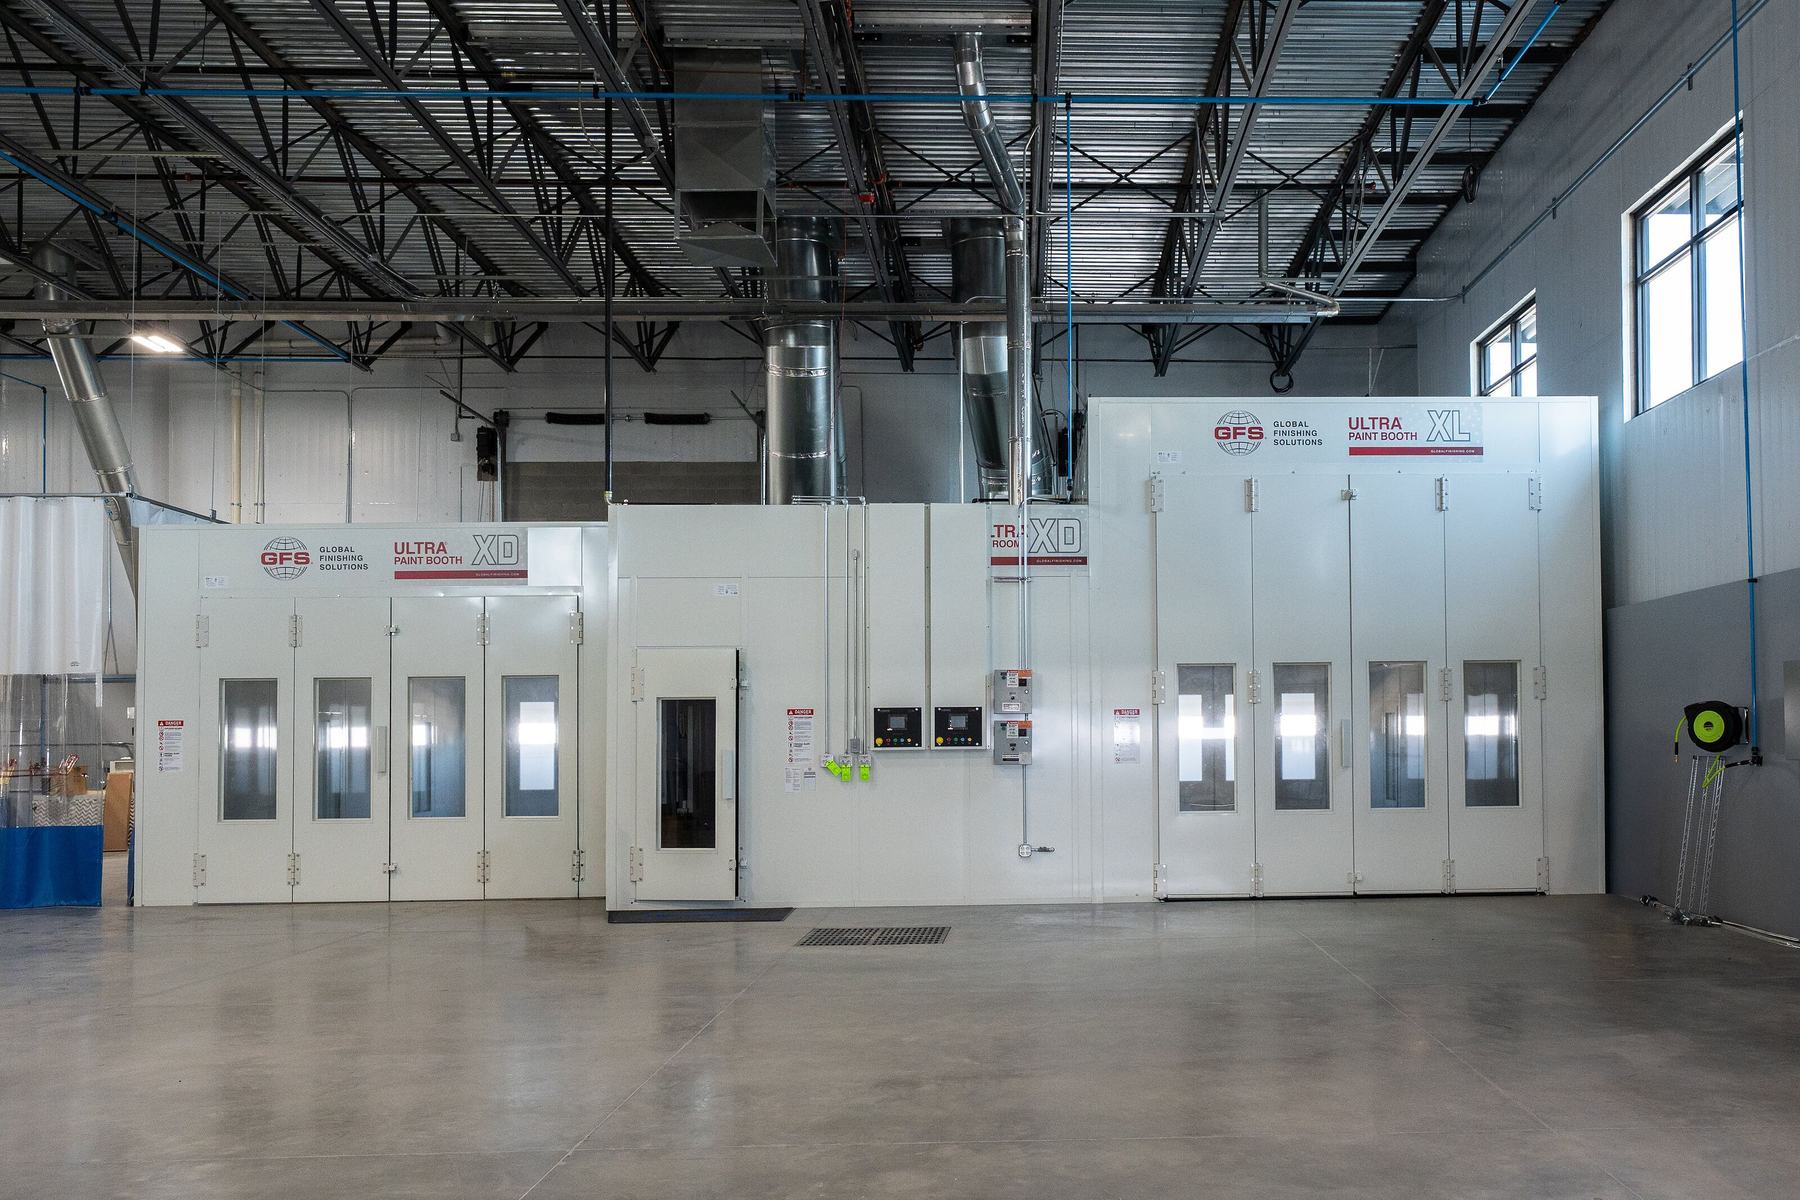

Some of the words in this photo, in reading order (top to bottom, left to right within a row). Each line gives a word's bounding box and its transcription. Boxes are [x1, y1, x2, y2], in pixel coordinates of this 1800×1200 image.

[1273, 420, 1309, 428] GLOBAL
[1348, 416, 1402, 430] ULTRA
[1426, 409, 1471, 442] XL
[1215, 426, 1264, 440] GFS
[1348, 432, 1378, 441] PAINT
[1380, 432, 1418, 441] BOOTH
[1028, 517, 1082, 554] XD
[394, 541, 447, 555] ULTRA
[471, 534, 519, 566] XD
[260, 552, 311, 566] GFS
[319, 554, 363, 562] FINISHING
[394, 556, 424, 565] PAINT
[426, 556, 463, 565] BOOTH
[319, 563, 369, 571] SOLUTIONS
